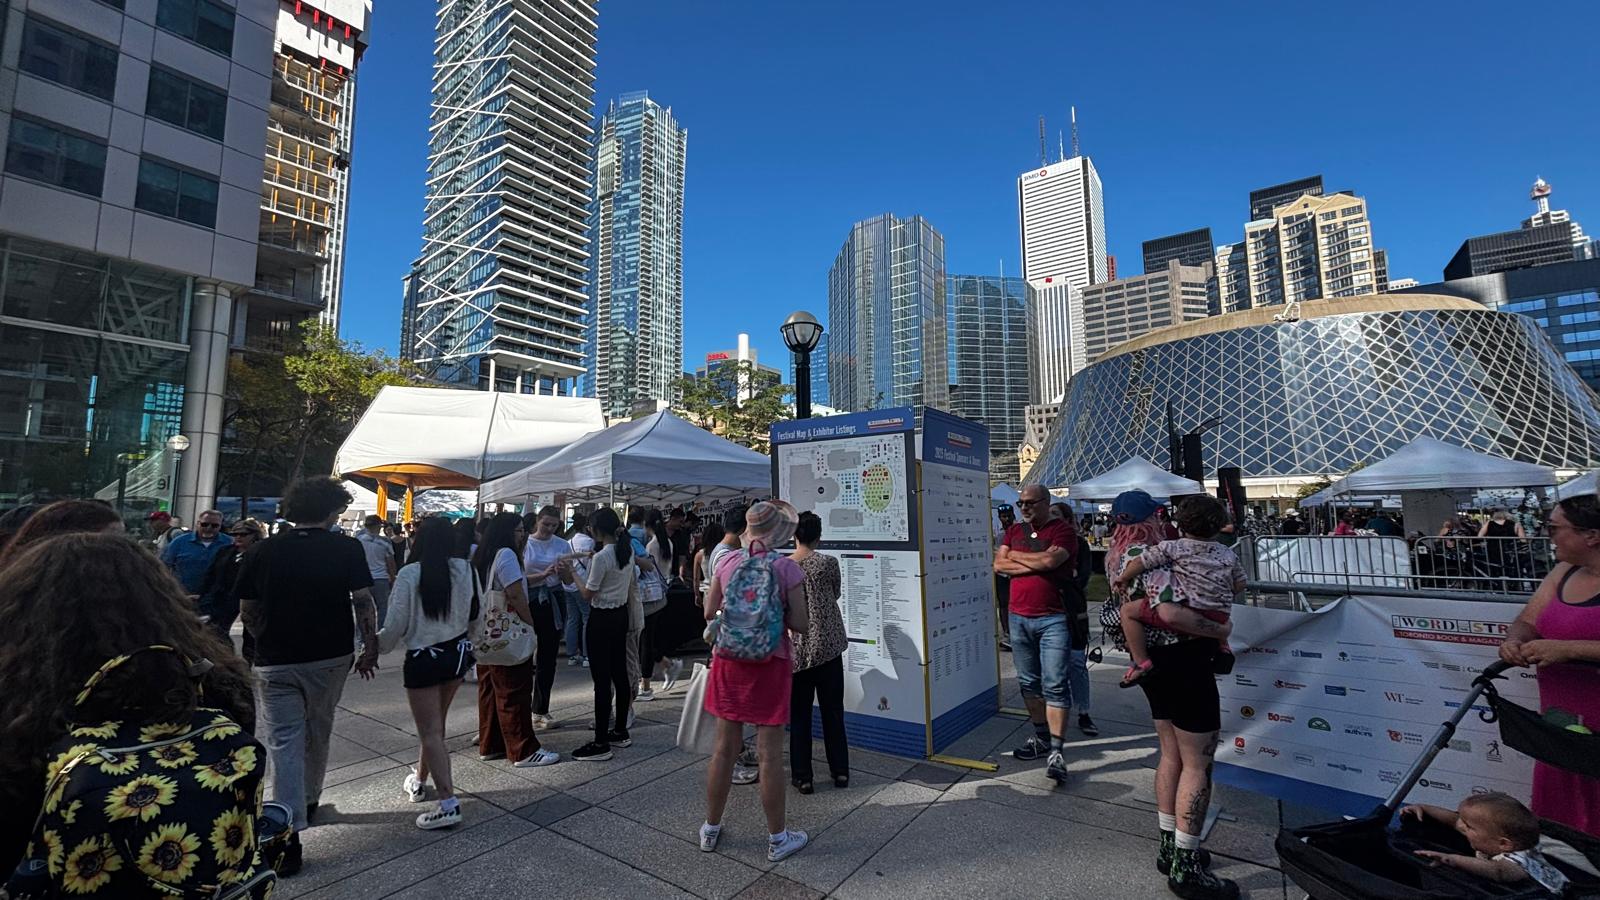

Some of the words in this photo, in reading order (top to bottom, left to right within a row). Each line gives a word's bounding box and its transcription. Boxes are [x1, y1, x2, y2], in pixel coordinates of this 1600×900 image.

[777, 430, 796, 441] Festival
[796, 430, 807, 440] Map
[813, 426, 834, 437] Exhibitor
[835, 424, 857, 435] Listings
[1402, 617, 1455, 631] WORD
[1473, 622, 1508, 634] STR
[1398, 630, 1436, 640] TORONTO
[1436, 634, 1460, 642] BOOK
[1469, 637, 1500, 646] MAGAZI
[1520, 672, 1537, 680] Ont
[1268, 712, 1280, 722] 50
[1344, 729, 1373, 738] authors
